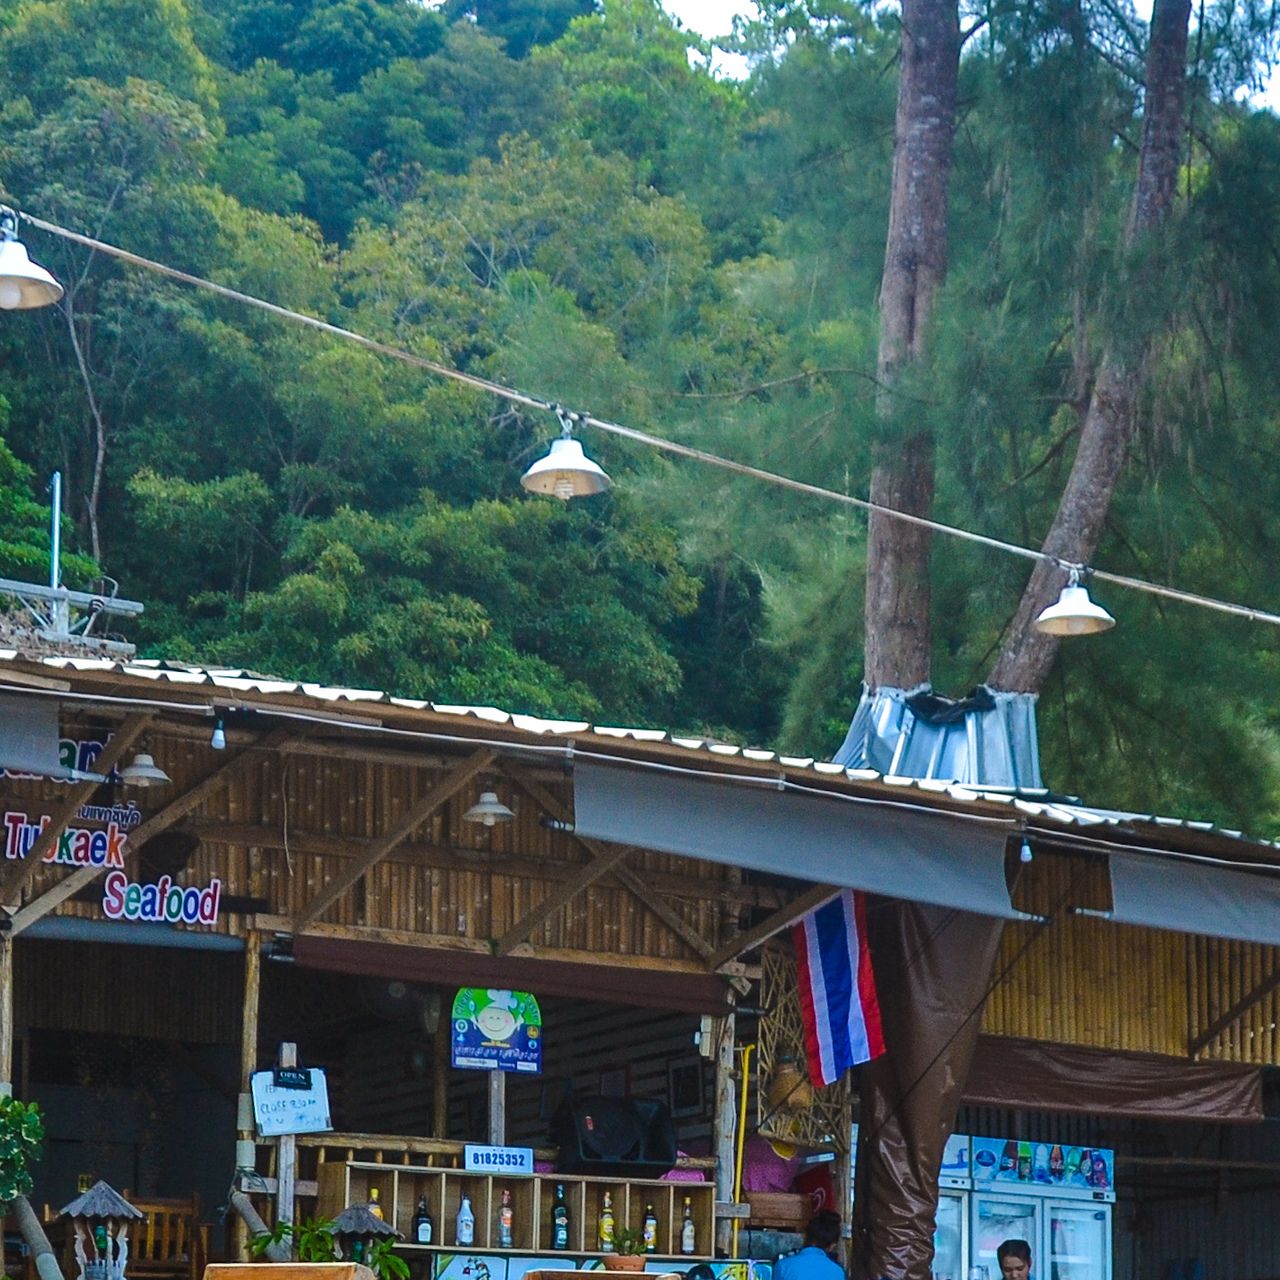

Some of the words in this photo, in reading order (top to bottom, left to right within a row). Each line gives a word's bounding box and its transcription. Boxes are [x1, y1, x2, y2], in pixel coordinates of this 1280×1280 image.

[103, 870, 220, 925] Seafood
[280, 1071, 306, 1080] OPEN
[472, 1152, 525, 1167] 81825352
